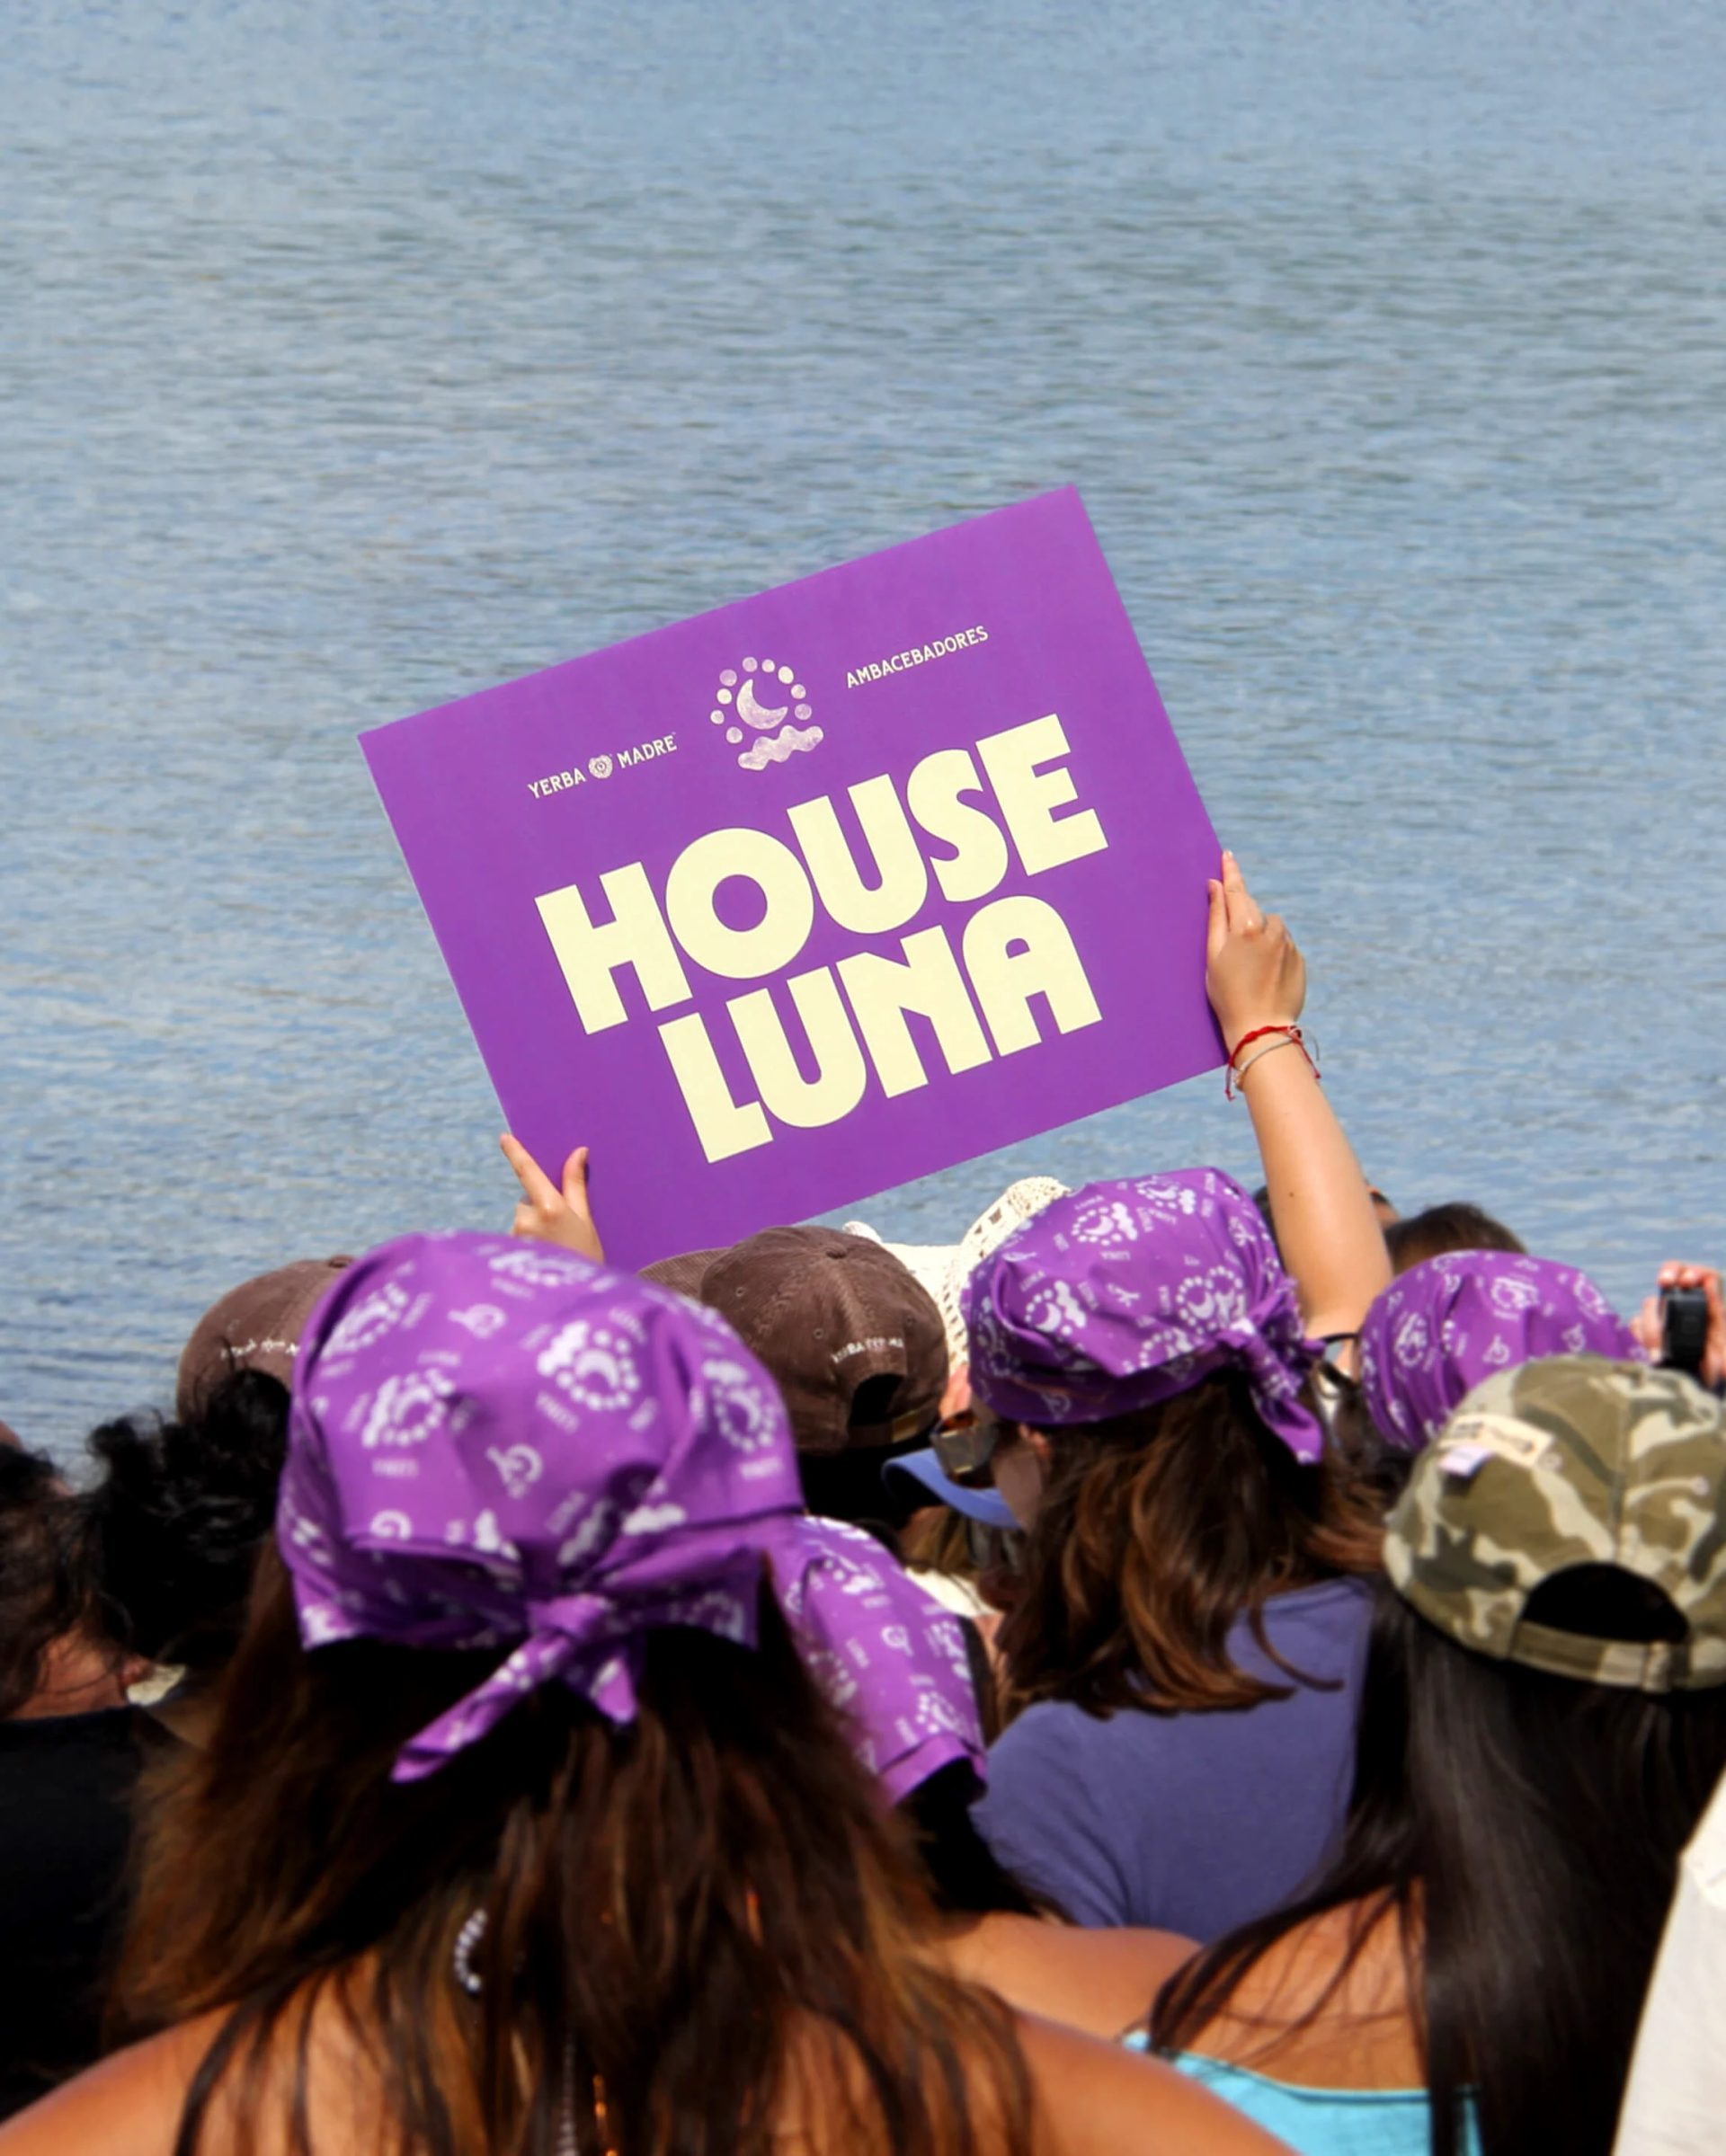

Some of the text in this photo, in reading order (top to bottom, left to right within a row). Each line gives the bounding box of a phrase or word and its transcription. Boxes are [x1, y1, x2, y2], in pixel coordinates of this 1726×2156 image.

[846, 625, 990, 688] AMBACEBADORES
[527, 733, 678, 800] YERBA MADRE
[534, 713, 1109, 1035] HOUSE
[657, 895, 1103, 1164] LUNA
